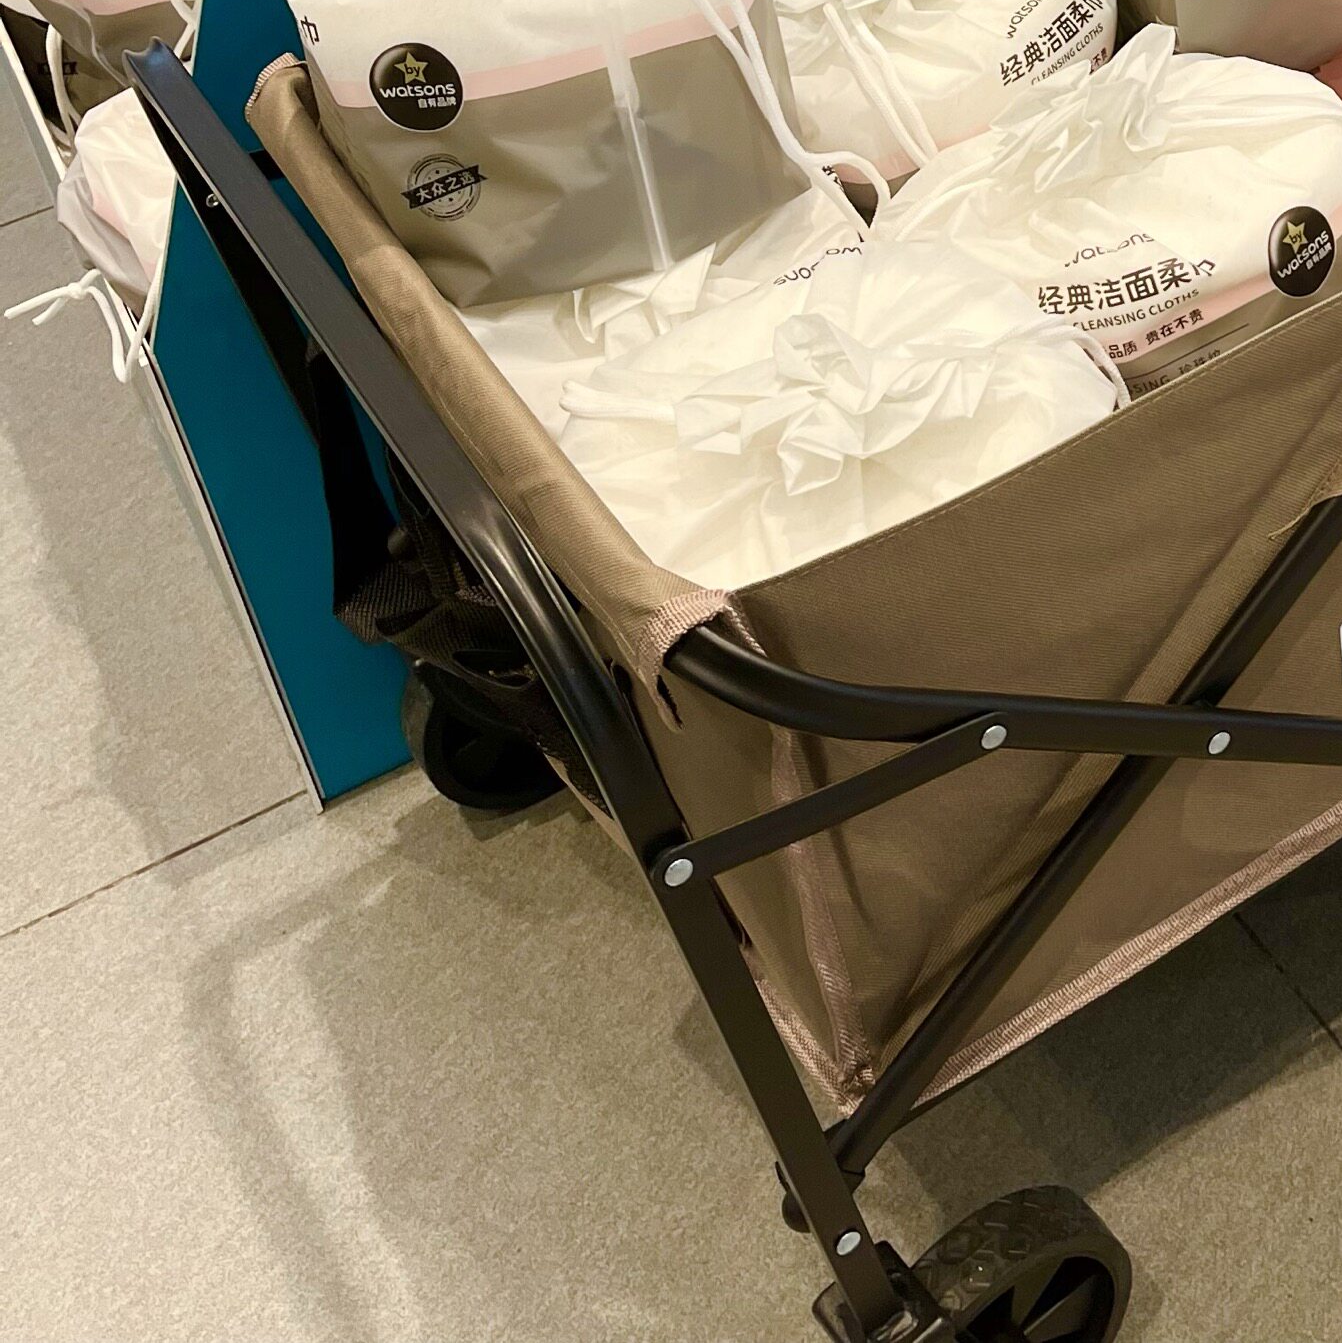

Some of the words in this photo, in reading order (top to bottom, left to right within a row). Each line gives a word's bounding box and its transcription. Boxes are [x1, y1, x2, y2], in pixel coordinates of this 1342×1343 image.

[1075, 22, 1104, 53] CLOTHS
[403, 64, 421, 77] by
[379, 82, 456, 99] watsons
[417, 96, 457, 109] 自有品牌
[415, 171, 475, 203] 大众之选
[1277, 230, 1329, 278] watsons
[1038, 258, 1216, 315] 经典洁面柔巾
[1149, 289, 1199, 315] CLOTHS
[1108, 340, 1138, 360] 品质
[1146, 308, 1204, 346] 贵在不贵
